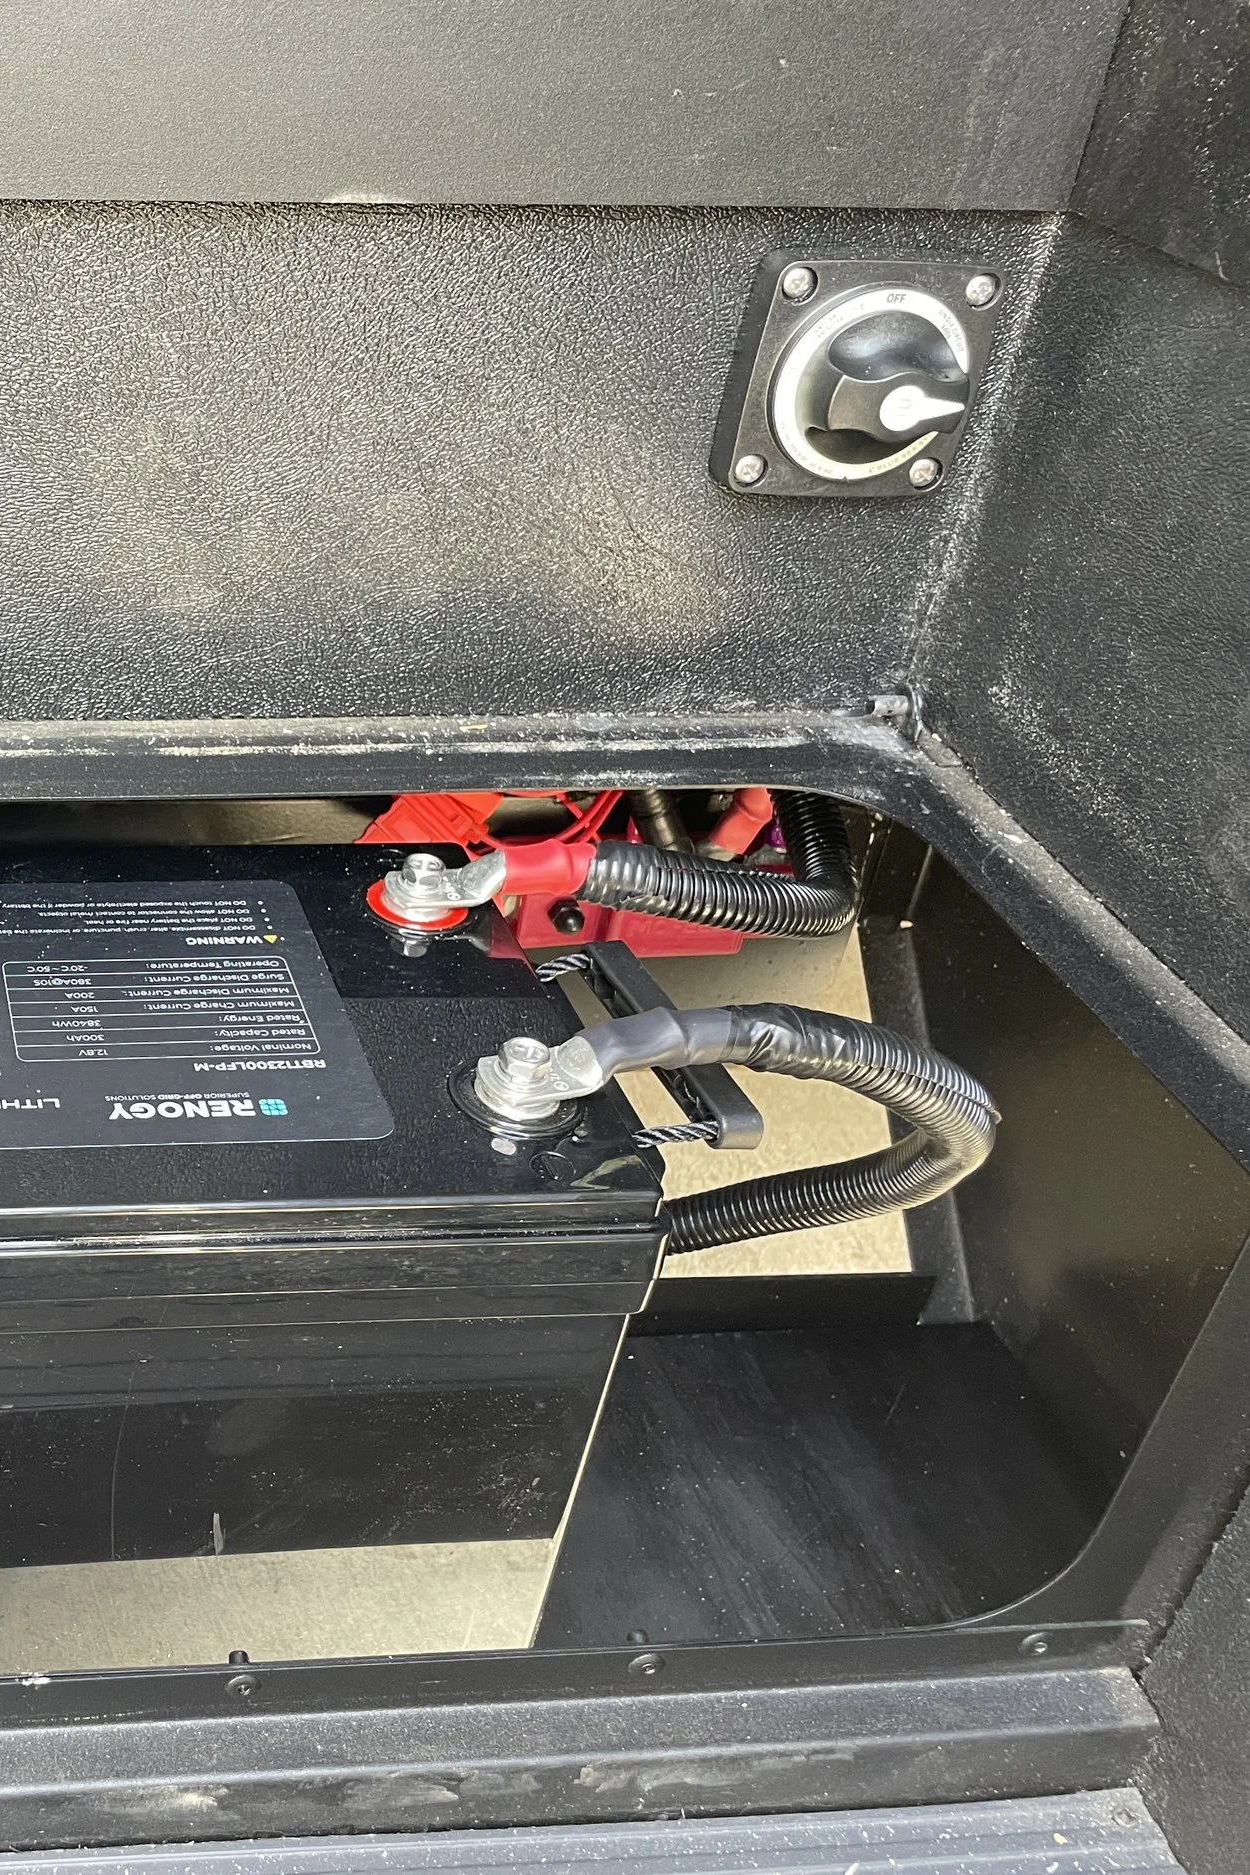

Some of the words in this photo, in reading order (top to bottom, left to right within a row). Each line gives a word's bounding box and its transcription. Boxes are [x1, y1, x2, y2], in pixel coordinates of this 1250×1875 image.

[886, 293, 906, 303] OFF
[185, 936, 264, 946] WARNING
[146, 961, 222, 970] Temperature:
[222, 960, 280, 968] Operating
[193, 974, 250, 982] Discharge
[252, 972, 284, 980] Surge
[174, 988, 230, 996] Discharge
[232, 986, 290, 994] Maximum
[193, 1001, 235, 1010] Charge
[238, 1000, 295, 1008] Maximum
[218, 1014, 264, 1022] Energy:
[266, 1014, 300, 1022] Rated
[52, 1020, 101, 1028] 3840Wh
[214, 1029, 269, 1038] Capacity:
[271, 1028, 306, 1036] Rated
[66, 1034, 104, 1042] 300Ah
[210, 1044, 260, 1052] Voltage:
[261, 1043, 312, 1052] Nominal
[78, 1048, 108, 1056] 12.8V
[194, 1060, 326, 1071] RBT12300LFP-M
[105, 1094, 156, 1102] SOLUTIONS
[158, 1092, 202, 1100] OFF-GRID
[109, 1099, 256, 1120] RENOGY
